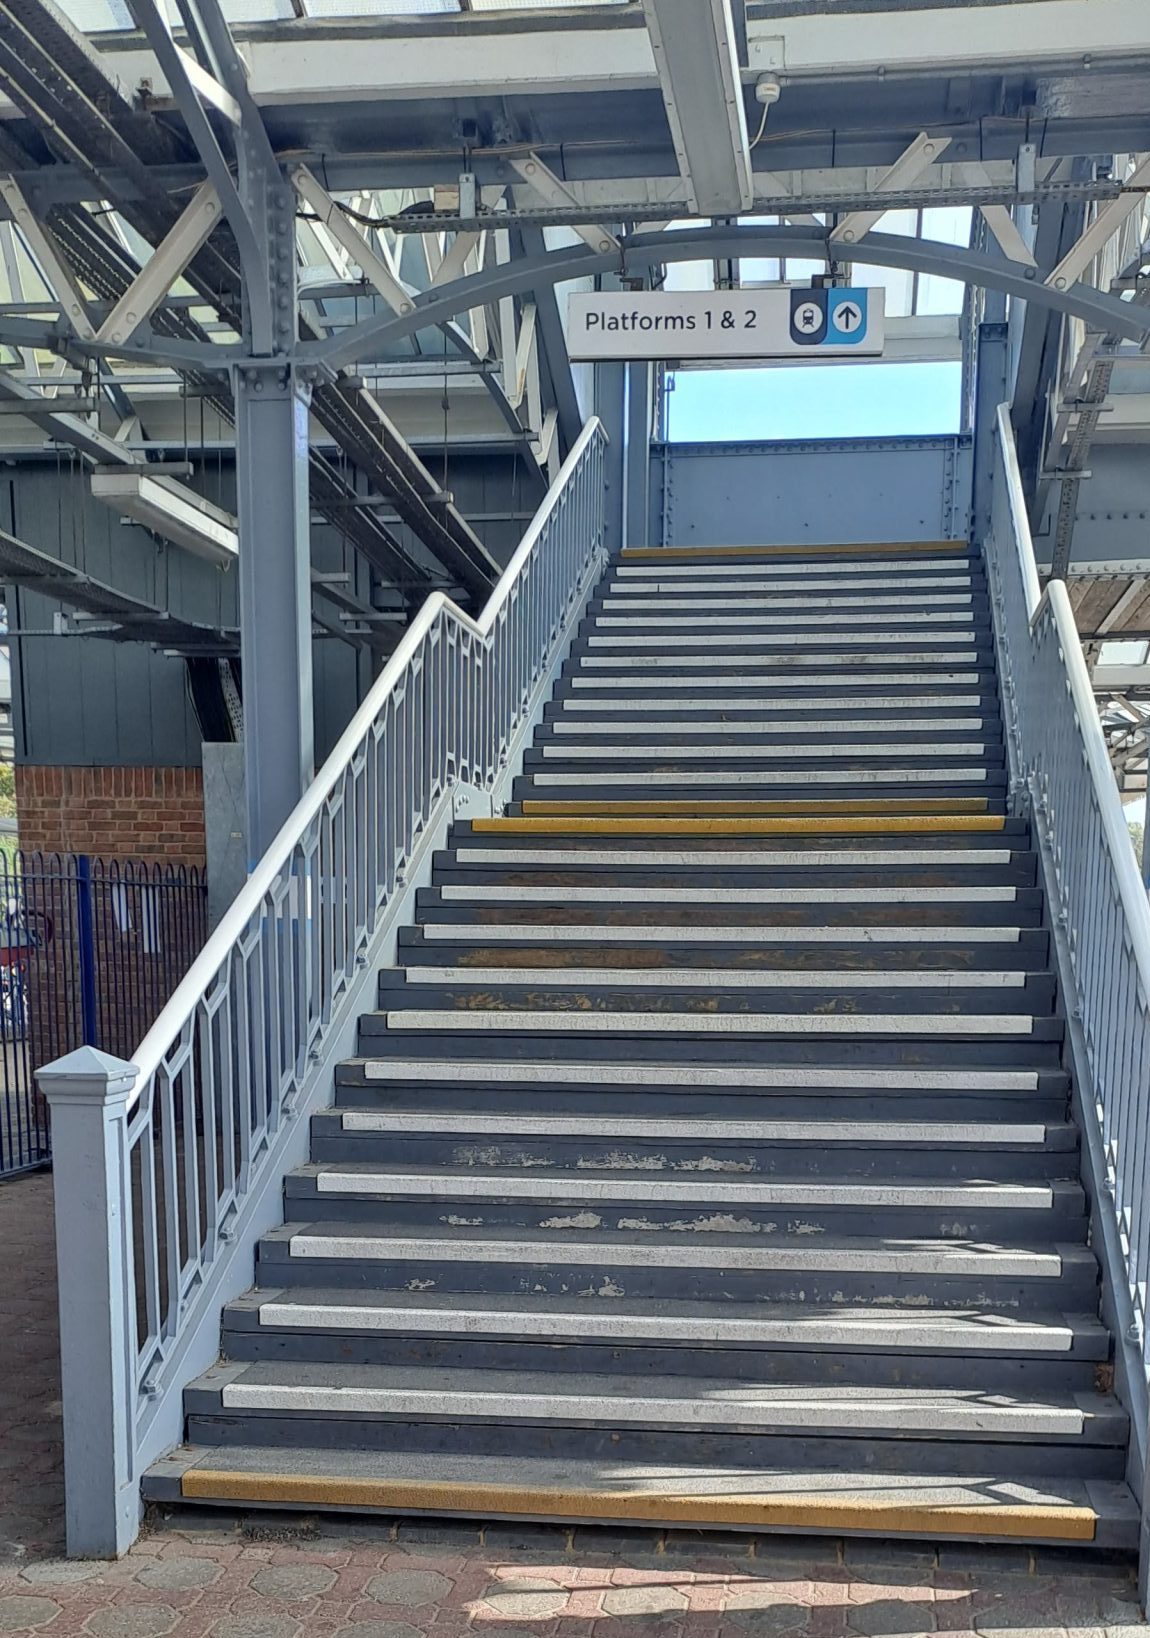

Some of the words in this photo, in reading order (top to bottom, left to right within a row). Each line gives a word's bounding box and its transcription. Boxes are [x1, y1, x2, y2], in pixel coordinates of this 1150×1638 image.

[585, 311, 696, 331] Platforms
[703, 310, 712, 330] 1
[720, 310, 736, 330] &
[743, 309, 757, 329] 2
